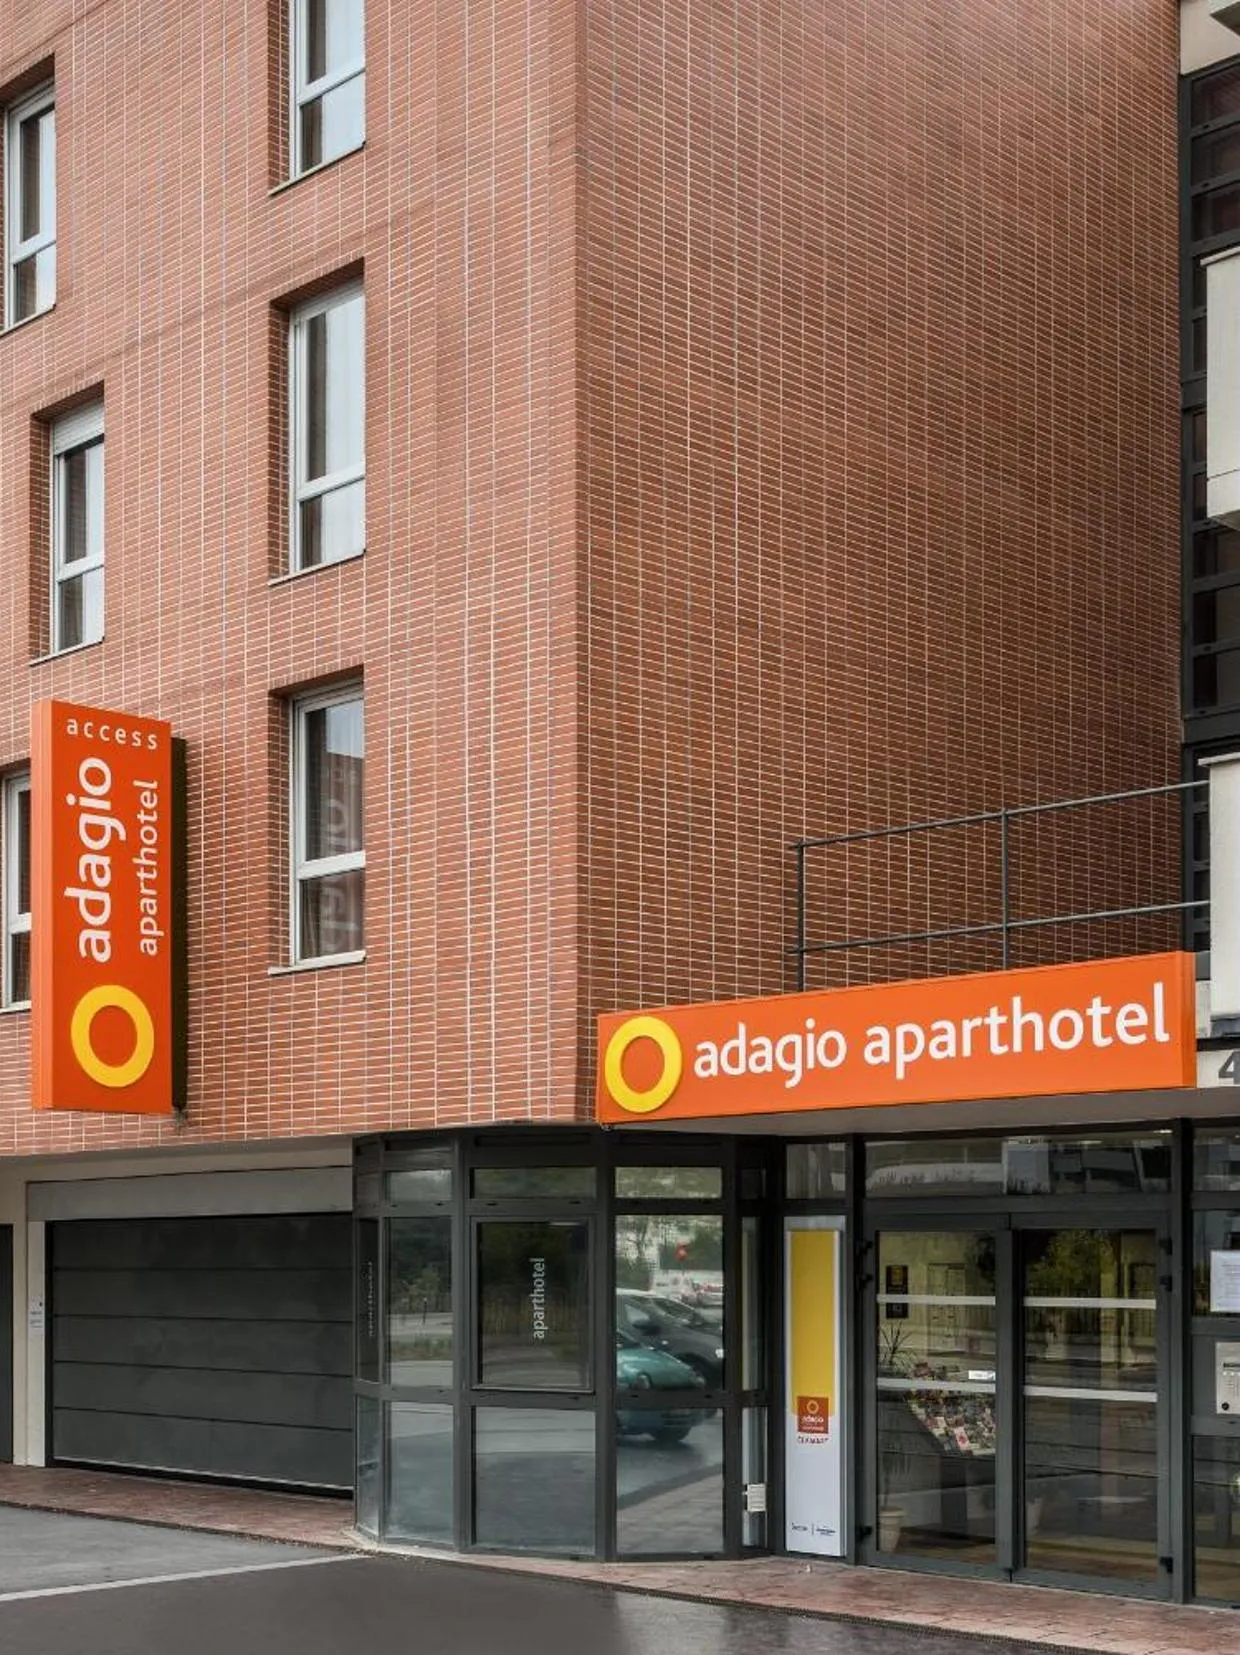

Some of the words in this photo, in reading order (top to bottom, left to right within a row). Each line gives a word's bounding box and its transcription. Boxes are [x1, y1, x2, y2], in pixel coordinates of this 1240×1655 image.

[66, 718, 158, 750] access
[63, 757, 127, 964] adagio
[132, 779, 165, 957] aparthotel
[693, 1017, 847, 1089] adagio
[863, 981, 1170, 1080] aparthotel
[529, 1257, 549, 1340] aparthotel
